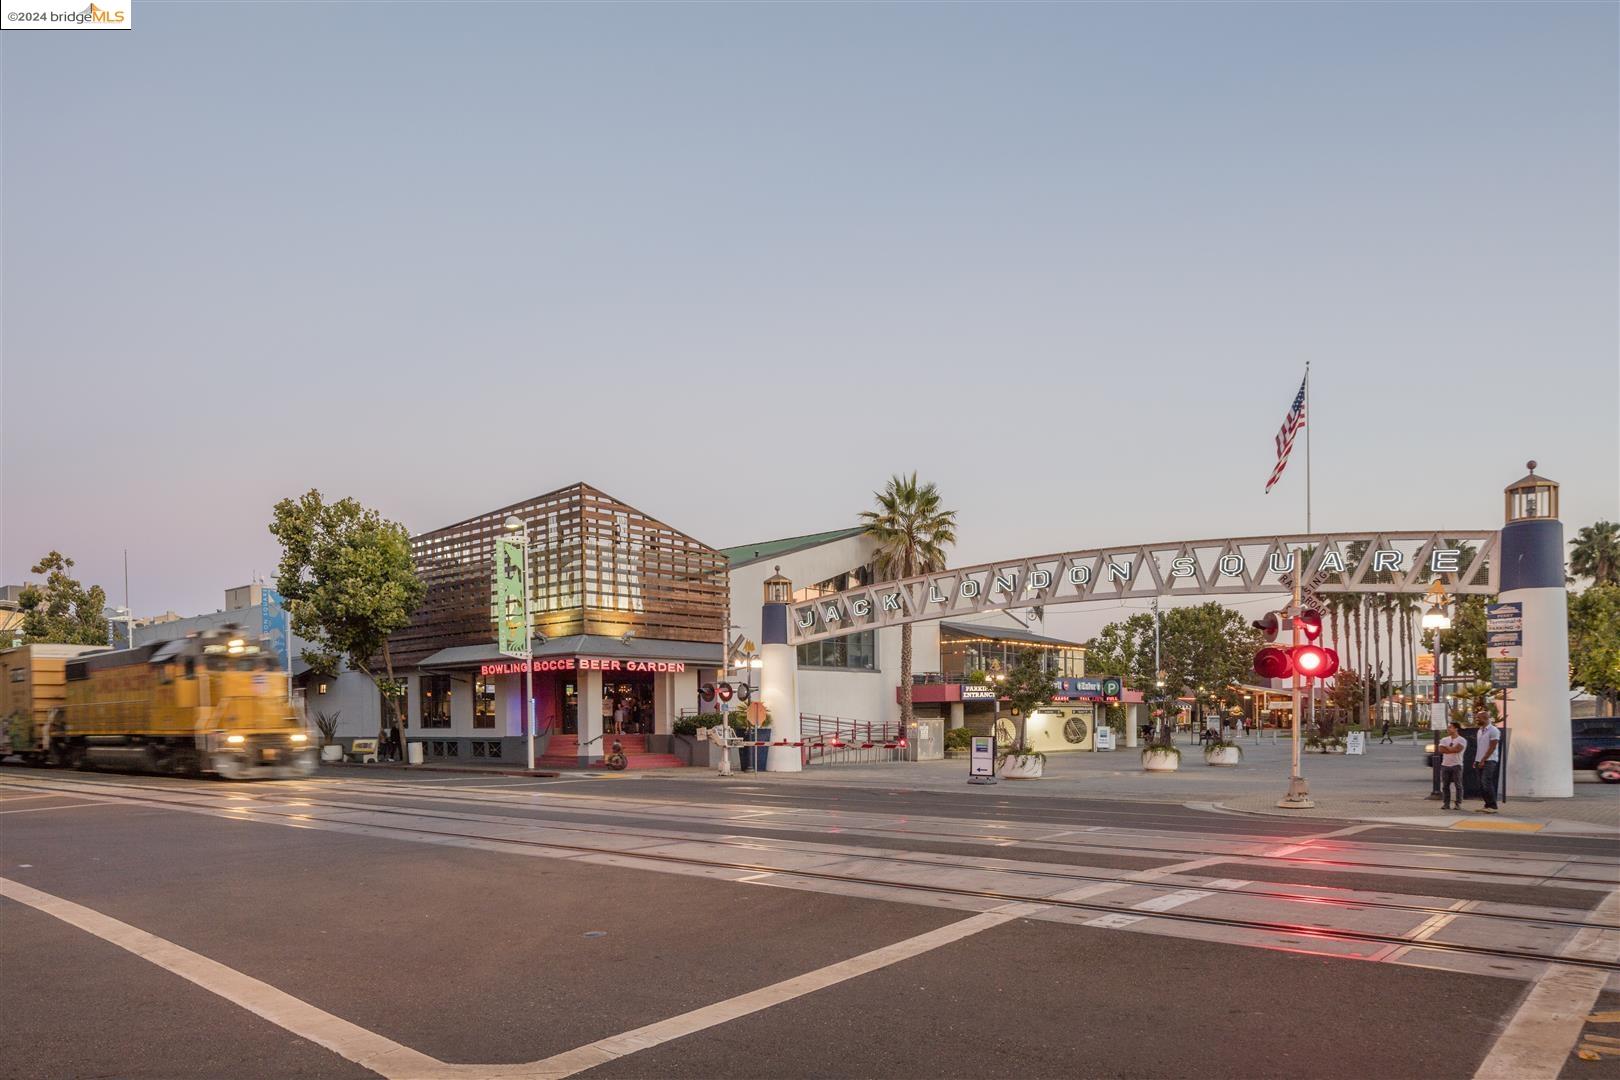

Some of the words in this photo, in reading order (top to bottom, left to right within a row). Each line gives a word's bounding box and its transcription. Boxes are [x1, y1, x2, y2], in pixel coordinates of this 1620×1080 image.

[799, 592, 901, 628] JACK
[929, 561, 1132, 604] LONDON
[1171, 549, 1460, 578] SQUARE
[481, 662, 528, 676] BOWLING
[533, 659, 575, 672] BOCCE
[579, 659, 621, 671] BEER
[626, 661, 685, 673] GARDEN
